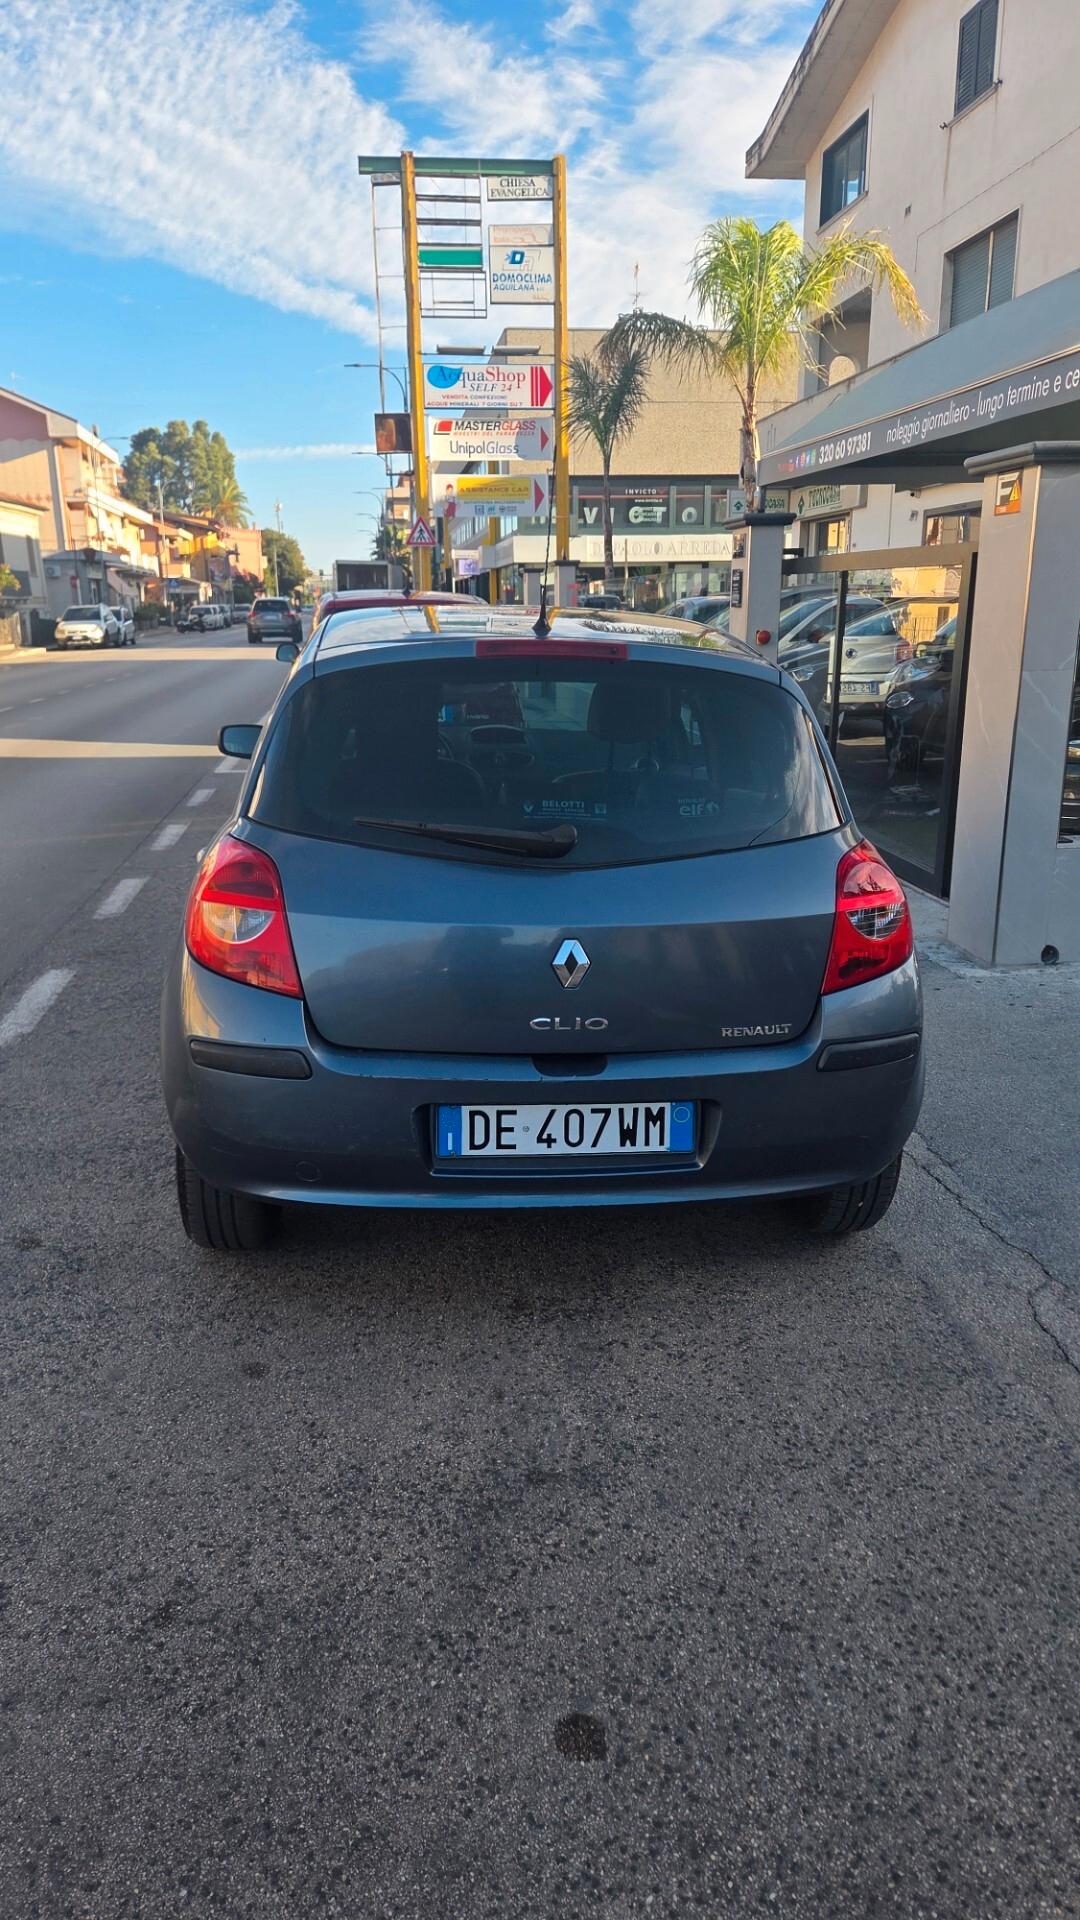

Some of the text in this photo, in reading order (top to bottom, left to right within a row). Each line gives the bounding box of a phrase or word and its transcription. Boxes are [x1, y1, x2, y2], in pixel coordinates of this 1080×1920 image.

[500, 178, 536, 187] CHIESA
[490, 187, 550, 197] EVANGELICA
[492, 273, 553, 283] DOMOCLIMA
[494, 283, 535, 291] AQUILANA
[436, 365, 527, 388] AcquaShop
[469, 383, 513, 392] SELF 24
[886, 416, 920, 445] noleggio
[922, 401, 970, 439] giornaliero
[977, 391, 1004, 420] lungo
[1006, 376, 1050, 407] termine
[1053, 375, 1062, 393] e
[454, 420, 536, 431] MASTERGLASS
[449, 440, 519, 458] UnipolGlass
[818, 431, 872, 464] 320 60 97381
[542, 800, 585, 808] BELOTTI
[679, 803, 705, 816] elf
[529, 1017, 609, 1031] CLIO
[721, 1023, 792, 1038] RENAULT
[468, 1109, 518, 1150] DE
[536, 1106, 666, 1149] 407WM
